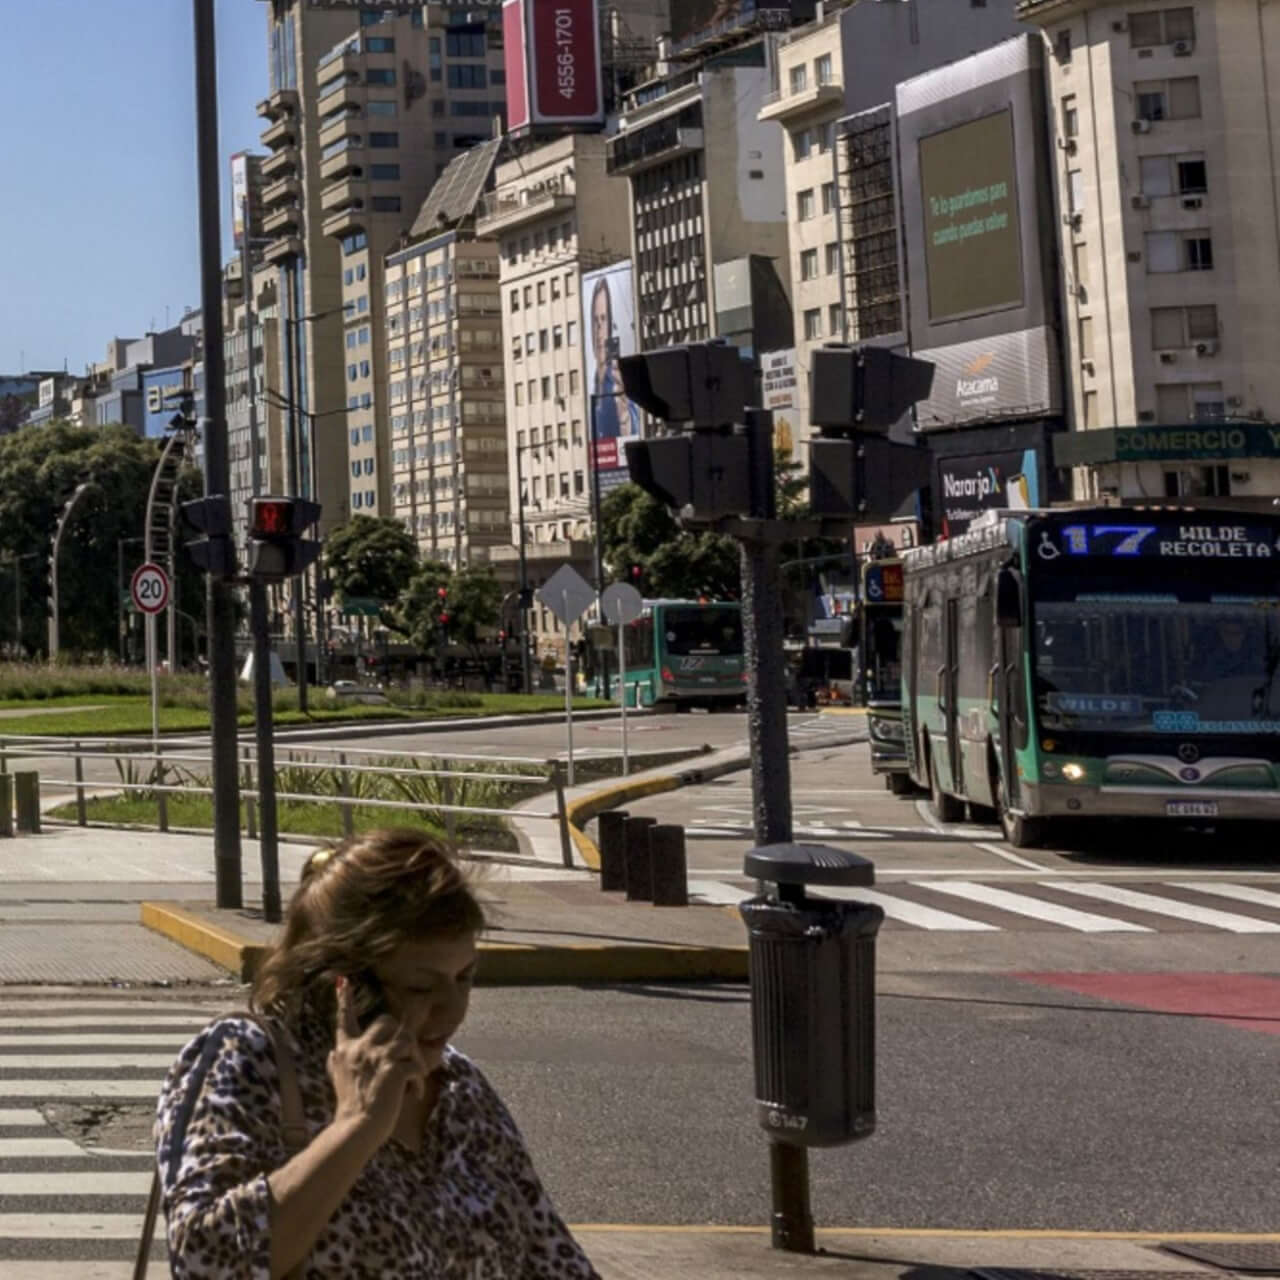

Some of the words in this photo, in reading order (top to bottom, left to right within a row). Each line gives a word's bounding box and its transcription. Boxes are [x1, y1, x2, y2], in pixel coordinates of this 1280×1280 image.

[555, 8, 576, 100] 4556-1701
[956, 376, 999, 397] Atacama
[1116, 429, 1246, 450] COMERCIO
[1061, 525, 1158, 556] 17
[1179, 525, 1248, 542] WILDE
[1159, 541, 1272, 558] RECOLETA
[140, 579, 161, 599] 20
[1058, 697, 1133, 712] WILDE
[781, 1113, 809, 1131] 147
